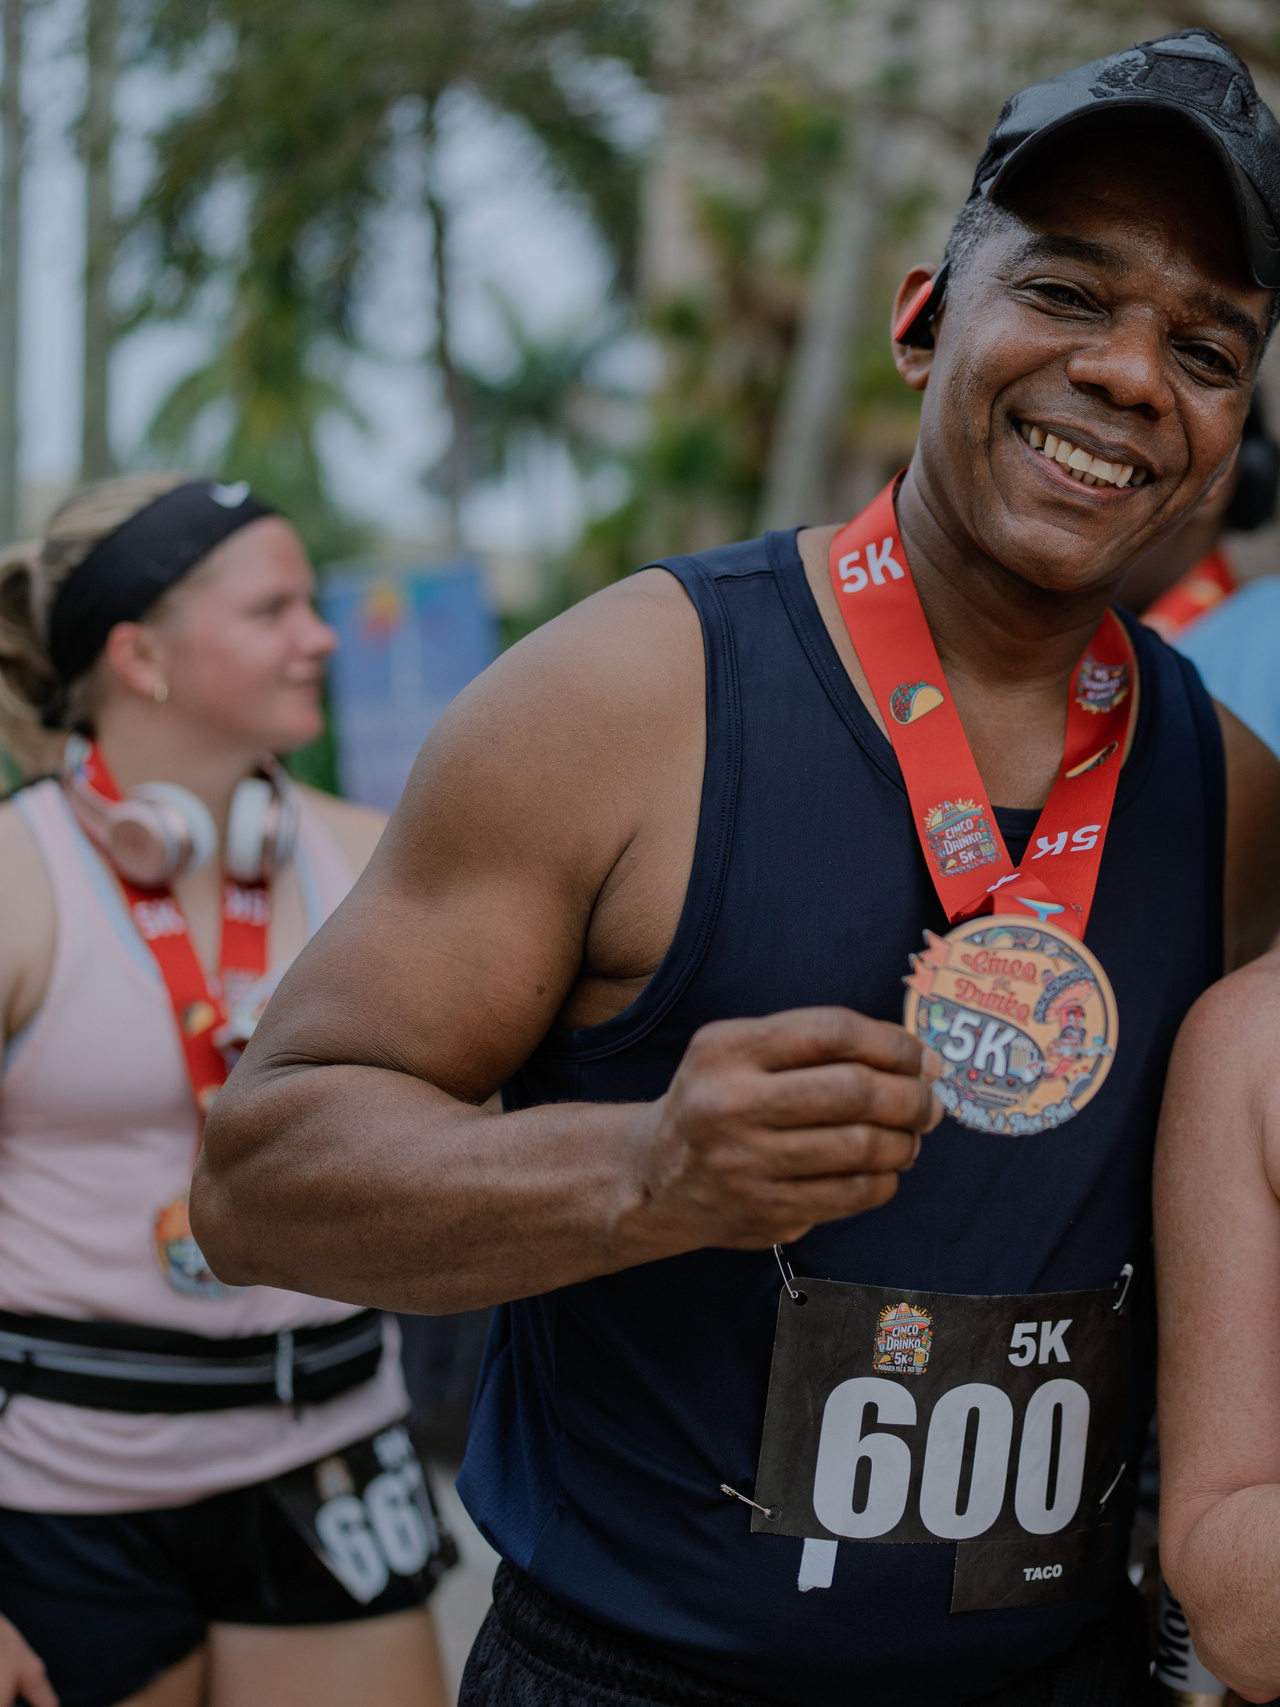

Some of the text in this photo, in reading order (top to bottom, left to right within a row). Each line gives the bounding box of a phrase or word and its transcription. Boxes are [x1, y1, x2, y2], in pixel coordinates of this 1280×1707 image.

[838, 536, 905, 594] 5K
[943, 831, 983, 856] DRINKO
[945, 818, 975, 840] CINCO
[1031, 824, 1102, 860] 5K
[959, 850, 977, 864] 5K
[961, 950, 1038, 985] Cinco
[955, 978, 1031, 1026] Drinko
[941, 1010, 1018, 1078] 5K
[886, 1335, 921, 1351] DRINKO
[892, 1324, 919, 1337] CINCO
[1007, 1319, 1074, 1367] 5K
[894, 1352, 908, 1365] 5K
[813, 1377, 1090, 1539] 600
[1023, 1564, 1063, 1581] TACO
